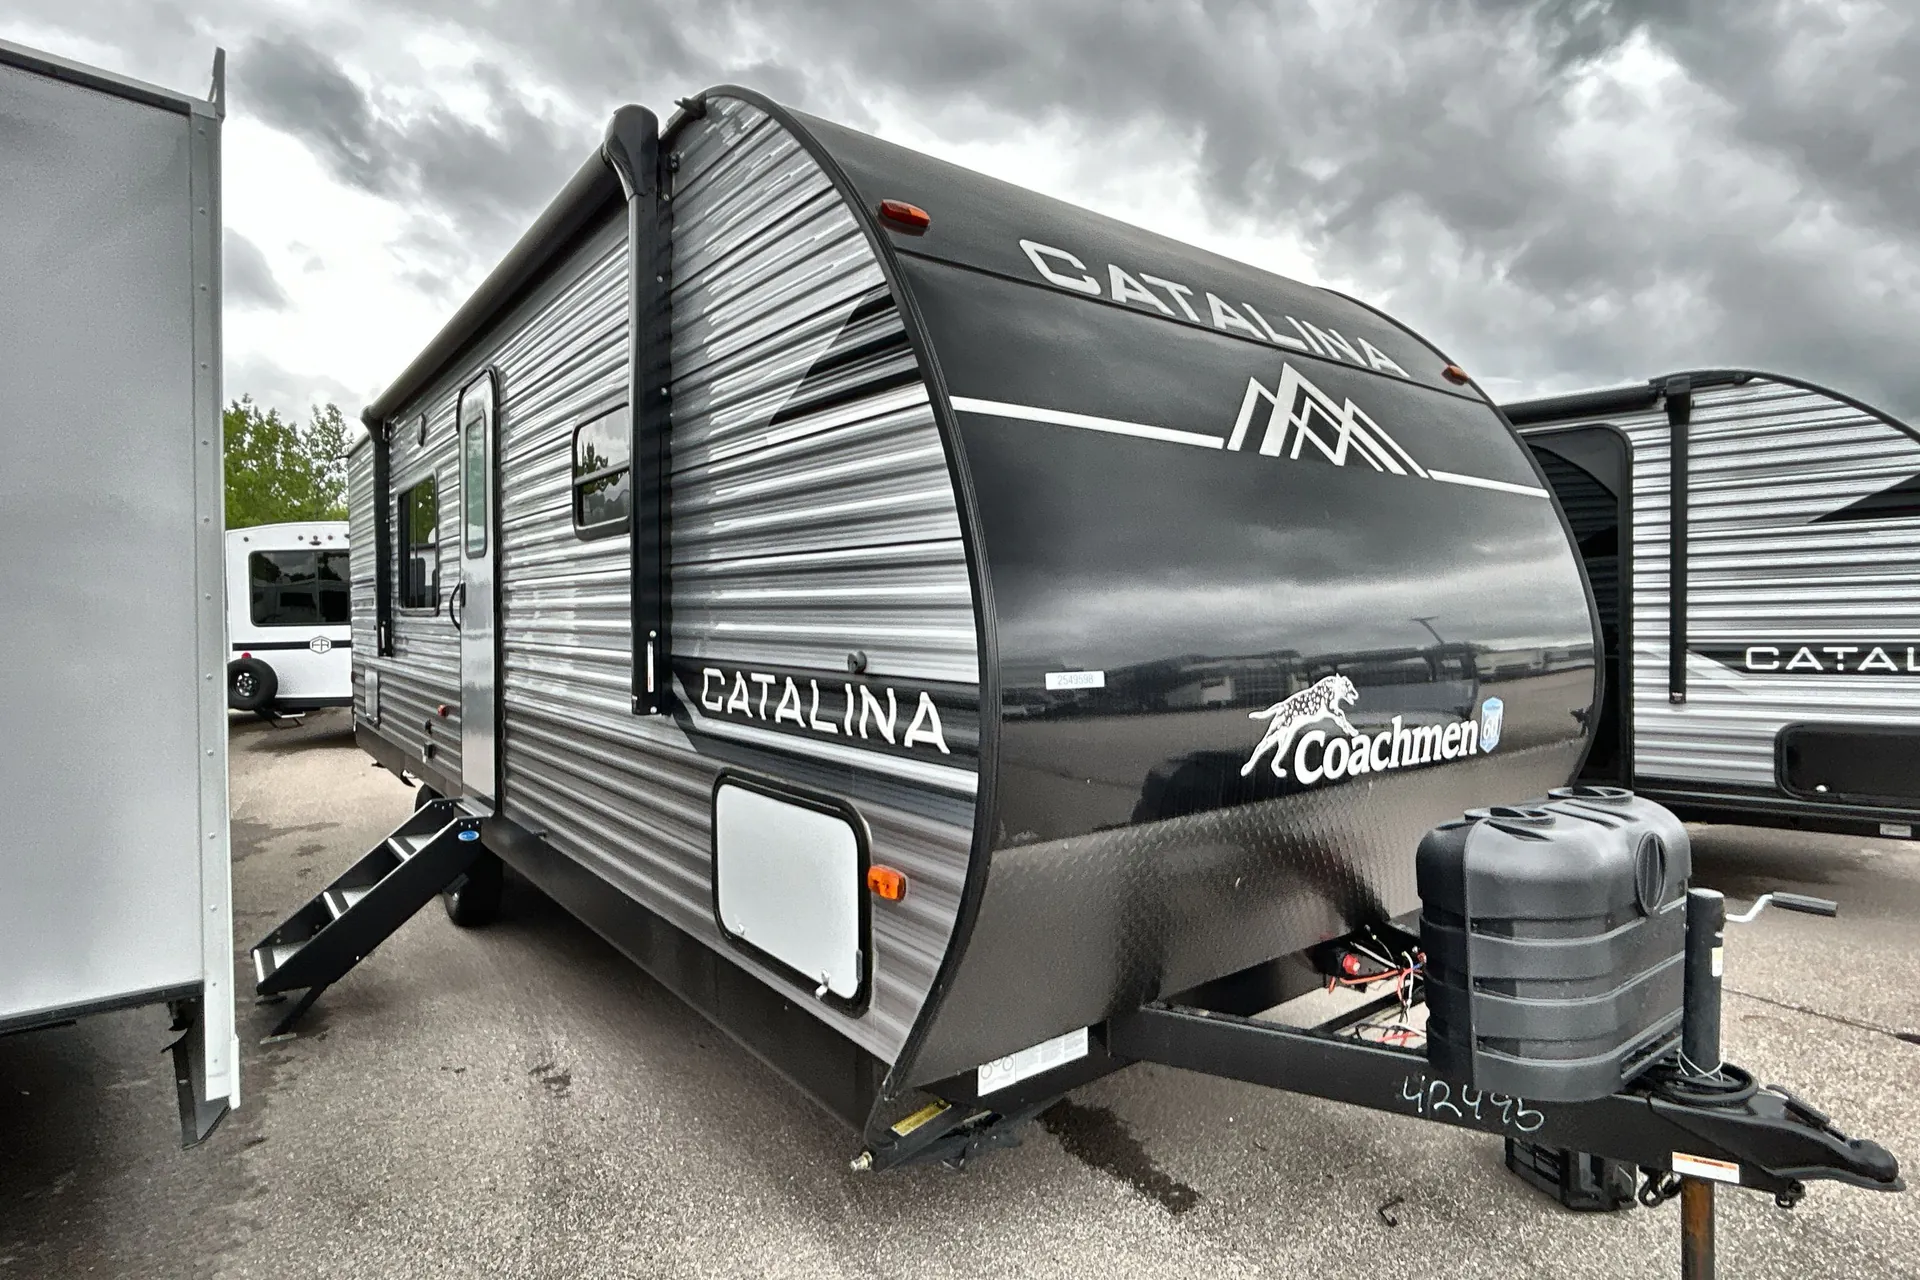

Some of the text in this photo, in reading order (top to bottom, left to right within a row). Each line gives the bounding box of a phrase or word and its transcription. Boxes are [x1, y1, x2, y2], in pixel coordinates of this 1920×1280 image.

[1019, 238, 1410, 378] CATALINA
[701, 667, 951, 755] CATALINA
[1294, 715, 1479, 785] Coachmen
